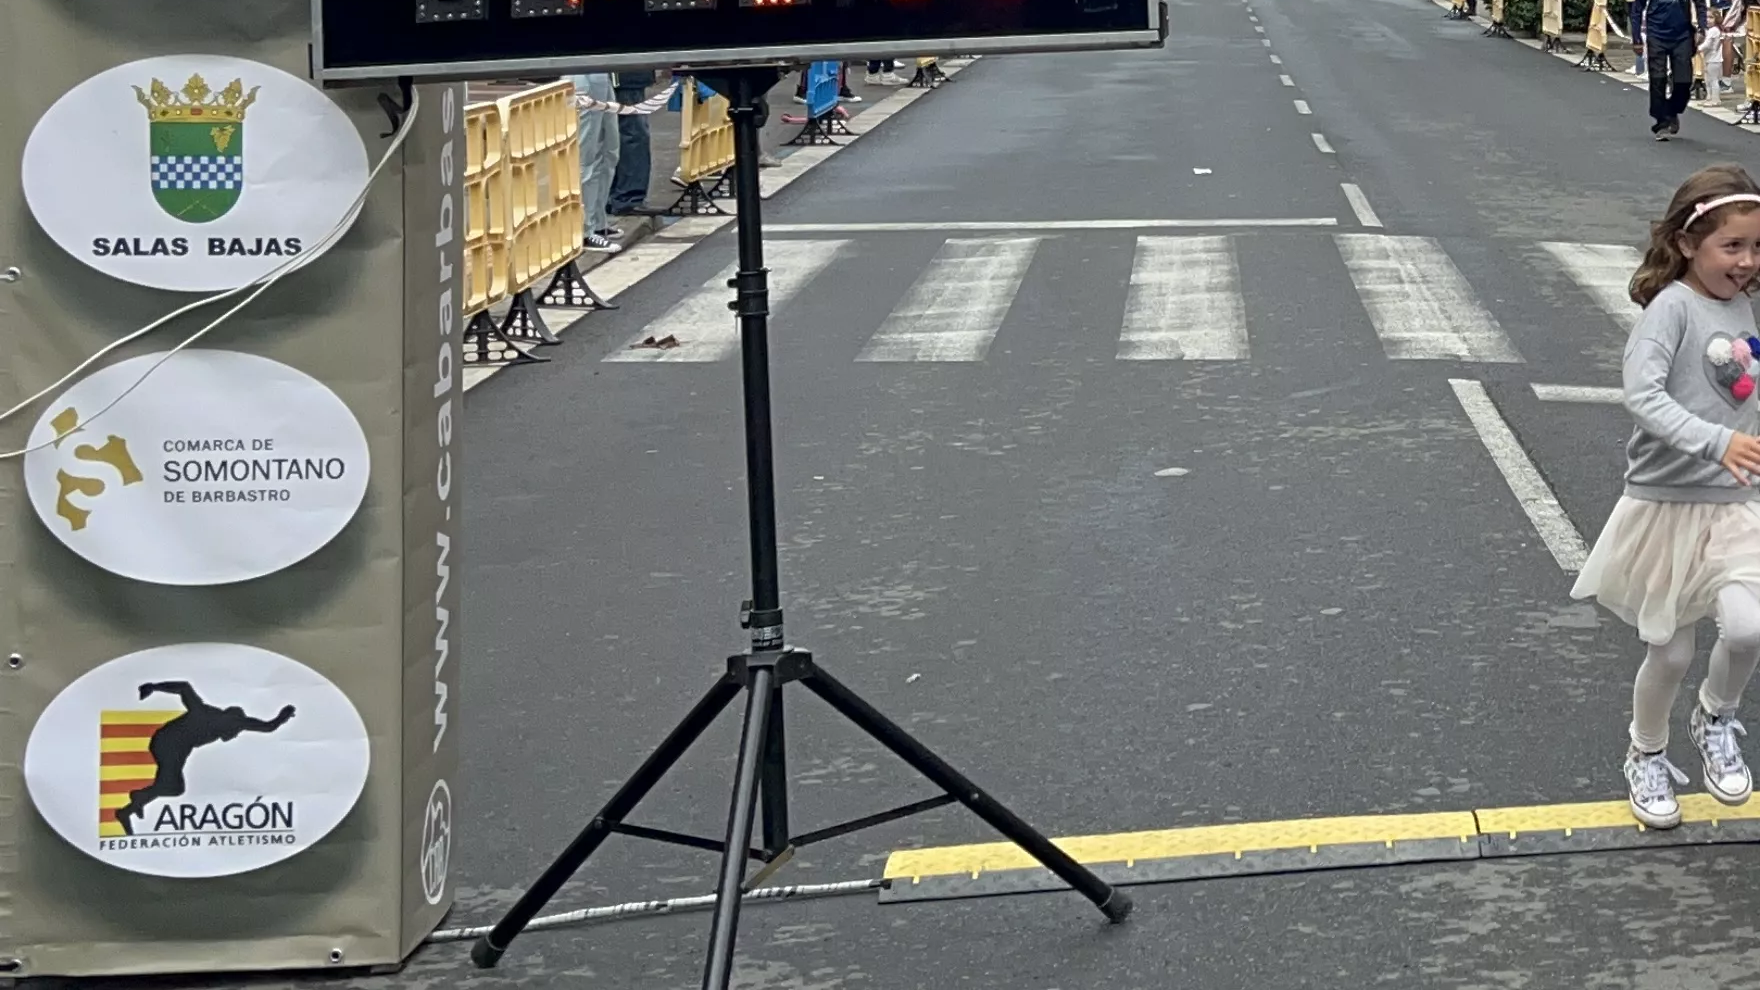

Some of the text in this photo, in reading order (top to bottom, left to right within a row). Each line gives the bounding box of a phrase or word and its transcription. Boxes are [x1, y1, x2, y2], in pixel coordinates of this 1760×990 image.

[92, 236, 304, 258] SALAS BAJAS
[163, 438, 274, 454] COMARCA DE
[163, 457, 346, 485] SOMONTANO
[163, 488, 292, 503] DE BARBASTRO
[153, 796, 294, 832] ARAGÓN
[99, 834, 297, 851] FEDERACIÓN ATLETISMO
